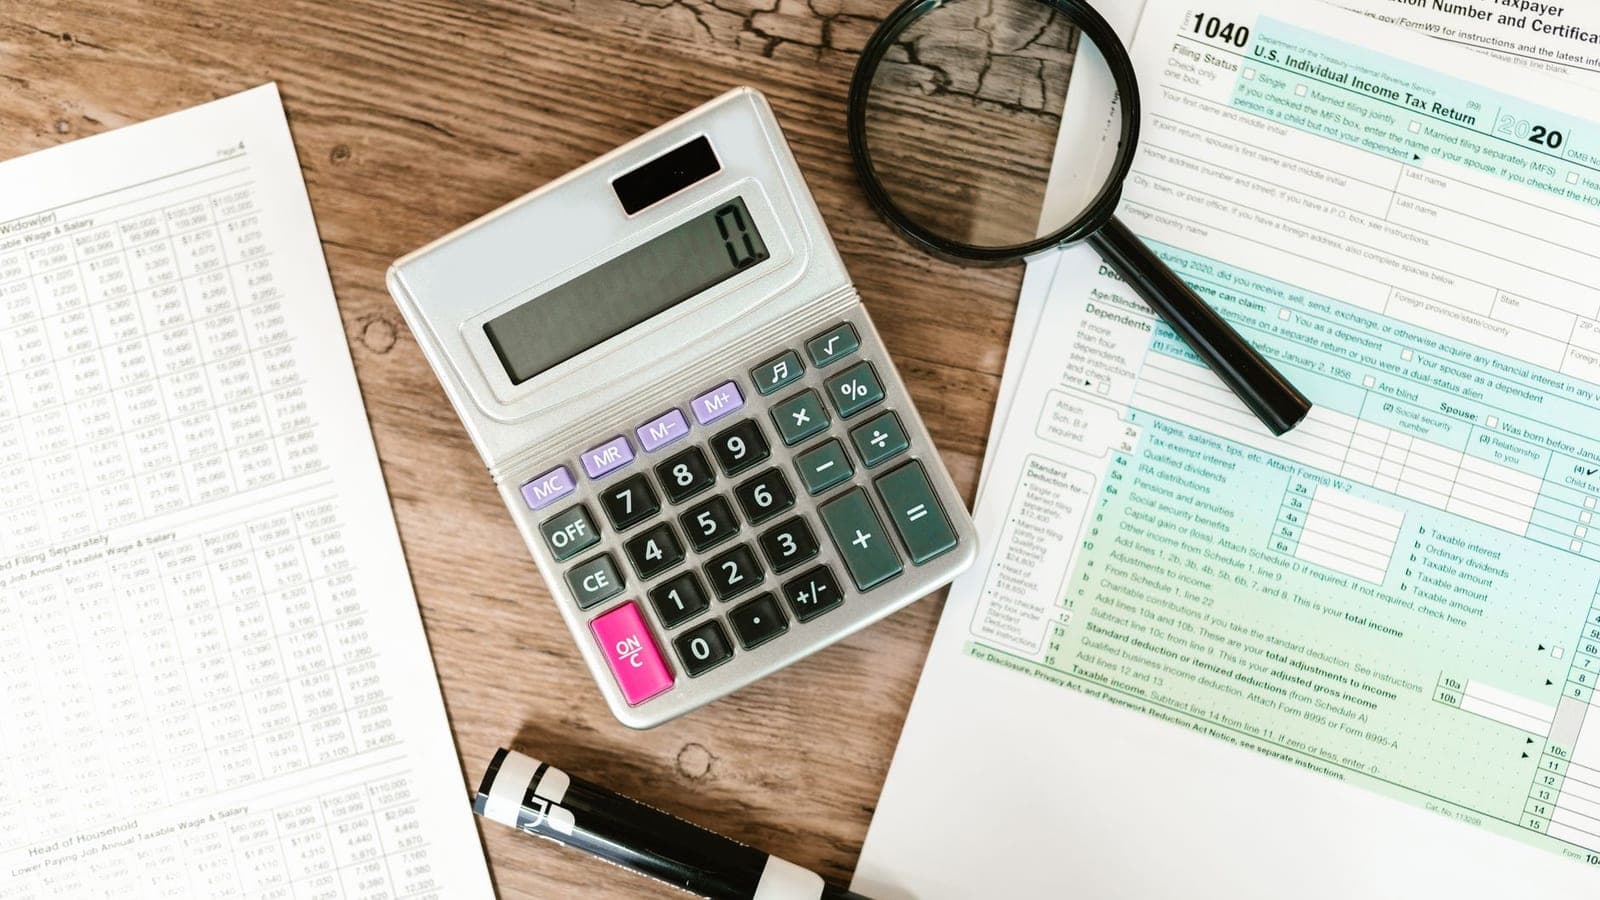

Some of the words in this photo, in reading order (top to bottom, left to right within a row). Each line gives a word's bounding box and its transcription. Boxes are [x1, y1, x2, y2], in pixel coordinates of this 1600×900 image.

[1431, 0, 1494, 21] Number
[1497, 14, 1527, 28] and
[1194, 13, 1249, 47] 1040
[1172, 43, 1201, 61] Filing
[1203, 54, 1237, 71] Status
[1442, 26, 1456, 36] for
[1459, 30, 1514, 49] instructions
[1517, 44, 1536, 53] and
[1538, 47, 1554, 57] the
[1556, 50, 1583, 64] latest
[1254, 44, 1279, 63] U.S.
[1283, 54, 1349, 84] Individual
[1351, 76, 1400, 101] Income
[1405, 92, 1428, 110] Tax
[1431, 102, 1476, 126] Return
[1258, 74, 1285, 89] Single
[1310, 90, 1345, 108] Married
[1346, 102, 1368, 117] filing
[1368, 109, 1396, 125] jointly
[1233, 98, 1264, 112] person
[1266, 106, 1274, 115] is
[1284, 113, 1305, 125] child
[1307, 119, 1322, 131] but
[1323, 126, 1338, 136] not
[1339, 131, 1360, 142] your
[1361, 138, 1409, 159] dependent
[1498, 114, 1563, 150] 2020
[1424, 127, 1458, 144] Married
[1460, 138, 1480, 153] filing
[1482, 147, 1528, 168] separately
[1529, 161, 1556, 178] (MFS)
[1406, 169, 1423, 180] Last
[1424, 176, 1446, 188] name
[1124, 204, 1153, 219] Foreign
[1155, 216, 1184, 230] country
[1185, 225, 1208, 236] name
[1500, 295, 1519, 306] State
[1085, 303, 1151, 332] Dependents
[1296, 315, 1311, 327] You
[1313, 323, 1324, 331] as
[1335, 329, 1382, 351] dependent
[1377, 382, 1394, 393] Are
[1396, 387, 1418, 401] blind
[1418, 356, 1438, 368] Your
[1440, 365, 1472, 380] spouse
[1474, 376, 1485, 384] as
[1495, 382, 1543, 403] dependent
[705, 393, 729, 412] M+
[1440, 402, 1478, 421] Spouse:
[1382, 402, 1394, 413] (2)
[1395, 406, 1420, 420] Social
[1421, 416, 1452, 431] security
[1398, 420, 1430, 434] number
[594, 447, 621, 468] MR
[728, 437, 745, 459] 9
[1149, 435, 1201, 459] Tax-exempt
[1202, 452, 1236, 470] interest
[1479, 434, 1490, 445] (3)
[1492, 438, 1539, 460] Relationship
[676, 464, 694, 487] 8
[1138, 463, 1154, 475] IRA
[1157, 470, 1210, 494] distributions
[1143, 450, 1183, 468] Qualified
[1184, 463, 1226, 483] dividends
[533, 476, 563, 500] MC
[755, 485, 772, 506] 6
[1133, 478, 1174, 497] Pensions
[1176, 494, 1193, 504] and
[1195, 500, 1234, 517] annuities
[616, 490, 631, 513] 7
[1129, 492, 1156, 507] Social
[1158, 504, 1193, 520] security
[1194, 514, 1230, 532] benefits
[552, 519, 585, 547] OFF
[698, 512, 716, 535] 5
[646, 540, 662, 560] 4
[778, 534, 796, 555] 3
[1432, 529, 1465, 547] Taxable
[1467, 542, 1501, 560] interest
[722, 562, 743, 584] 2
[1423, 557, 1456, 575] Taxable
[1458, 571, 1492, 587] amount
[1426, 544, 1465, 564] Ordinary
[1466, 558, 1509, 578] dividends
[584, 570, 609, 591] CE
[797, 582, 826, 603] +/-
[1418, 572, 1451, 590] Taxable
[1453, 586, 1488, 602] amount
[669, 590, 684, 609] 1
[1413, 586, 1446, 604] Taxable
[1449, 600, 1483, 616] amount
[692, 638, 709, 659] 0
[1086, 622, 1129, 642] Standard
[1131, 638, 1178, 659] deduction
[1192, 657, 1233, 677] itemized
[1235, 672, 1287, 696] deductions
[1289, 690, 1312, 704] (from
[1314, 699, 1356, 719] Schedule
[1357, 713, 1368, 724] A)
[1446, 679, 1460, 689] 10a
[1441, 693, 1455, 703] 10b
[970, 648, 986, 659] For
[986, 653, 1032, 676] Disclosure,
[1033, 669, 1065, 687] Privacy
[1065, 681, 1082, 693] Act,
[1084, 688, 1101, 698] and
[1102, 692, 1147, 714] Paperwork
[1148, 708, 1190, 728] Reduction
[1192, 723, 1207, 734] Act
[1208, 728, 1237, 746] Notice,
[1239, 740, 1254, 750] see
[1256, 746, 1292, 762] separate
[1294, 757, 1345, 781] instructions.
[1550, 746, 1566, 756] 10c
[1550, 762, 1558, 770] 11
[1544, 776, 1555, 786] 12
[1540, 791, 1549, 799] 13
[1535, 806, 1544, 814] 14
[1529, 819, 1540, 829] 15
